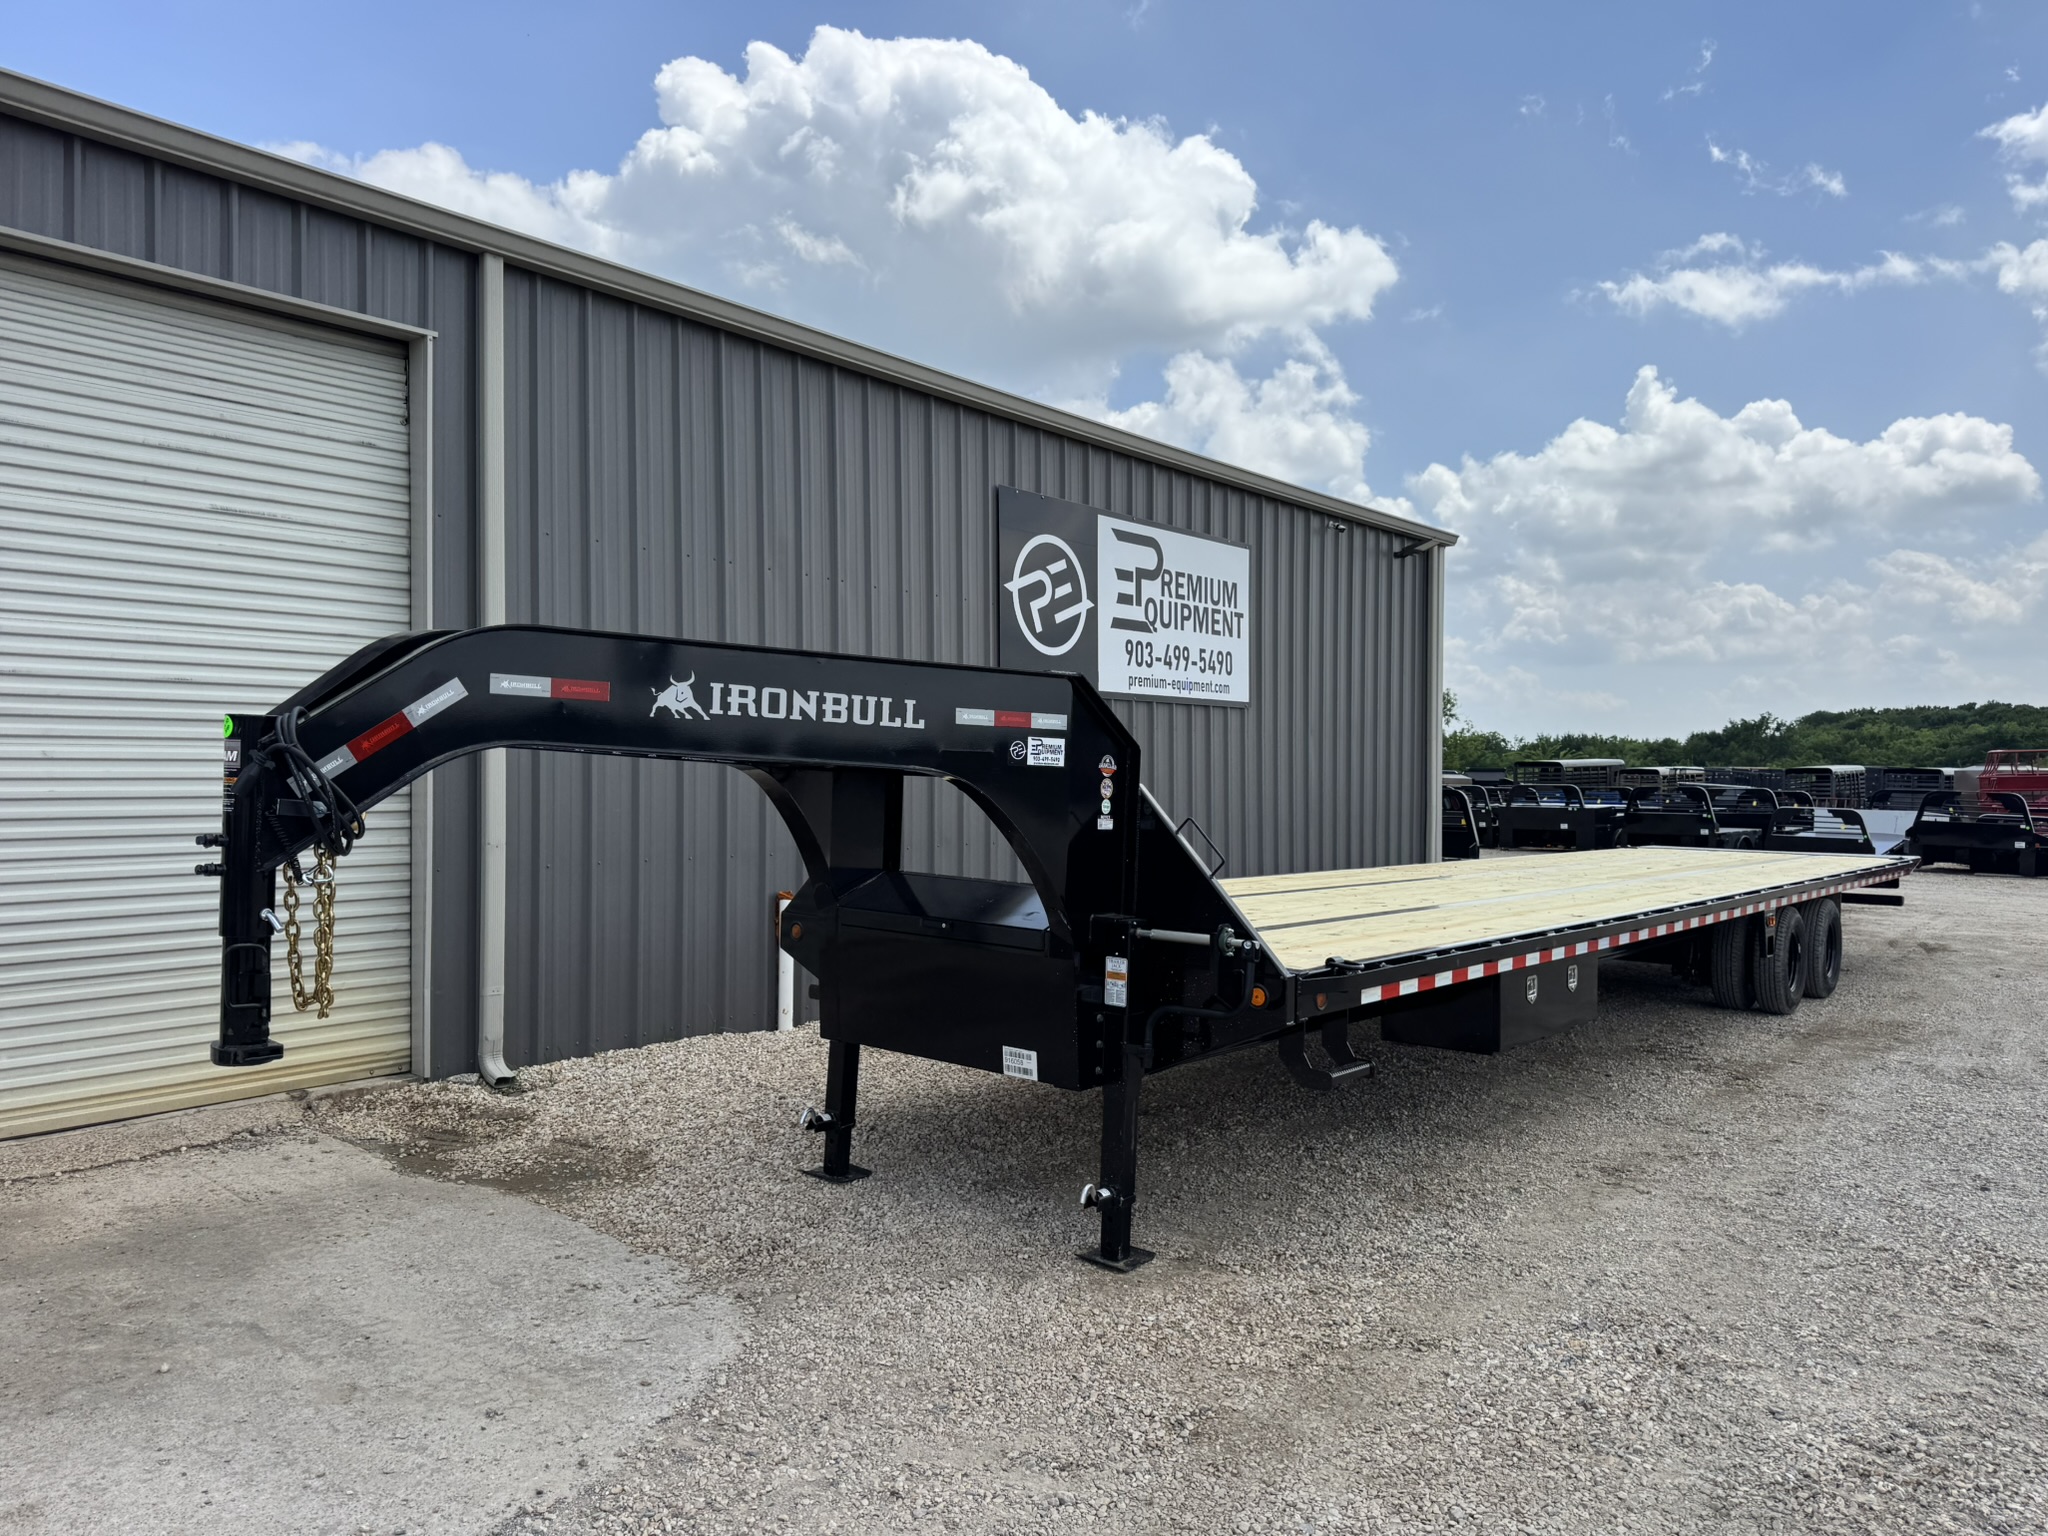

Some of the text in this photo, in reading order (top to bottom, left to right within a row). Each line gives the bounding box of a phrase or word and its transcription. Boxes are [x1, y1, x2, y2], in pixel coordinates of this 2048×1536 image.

[1111, 528, 1238, 609] PREMIUM
[1110, 568, 1244, 639] EQUIPMENT
[1125, 639, 1233, 677] 903-499-5490
[425, 689, 455, 709] IRONBULL
[510, 681, 542, 689] IRONBULL
[1128, 674, 1230, 695] premium-equipment.com
[709, 682, 925, 729] IRONBULL
